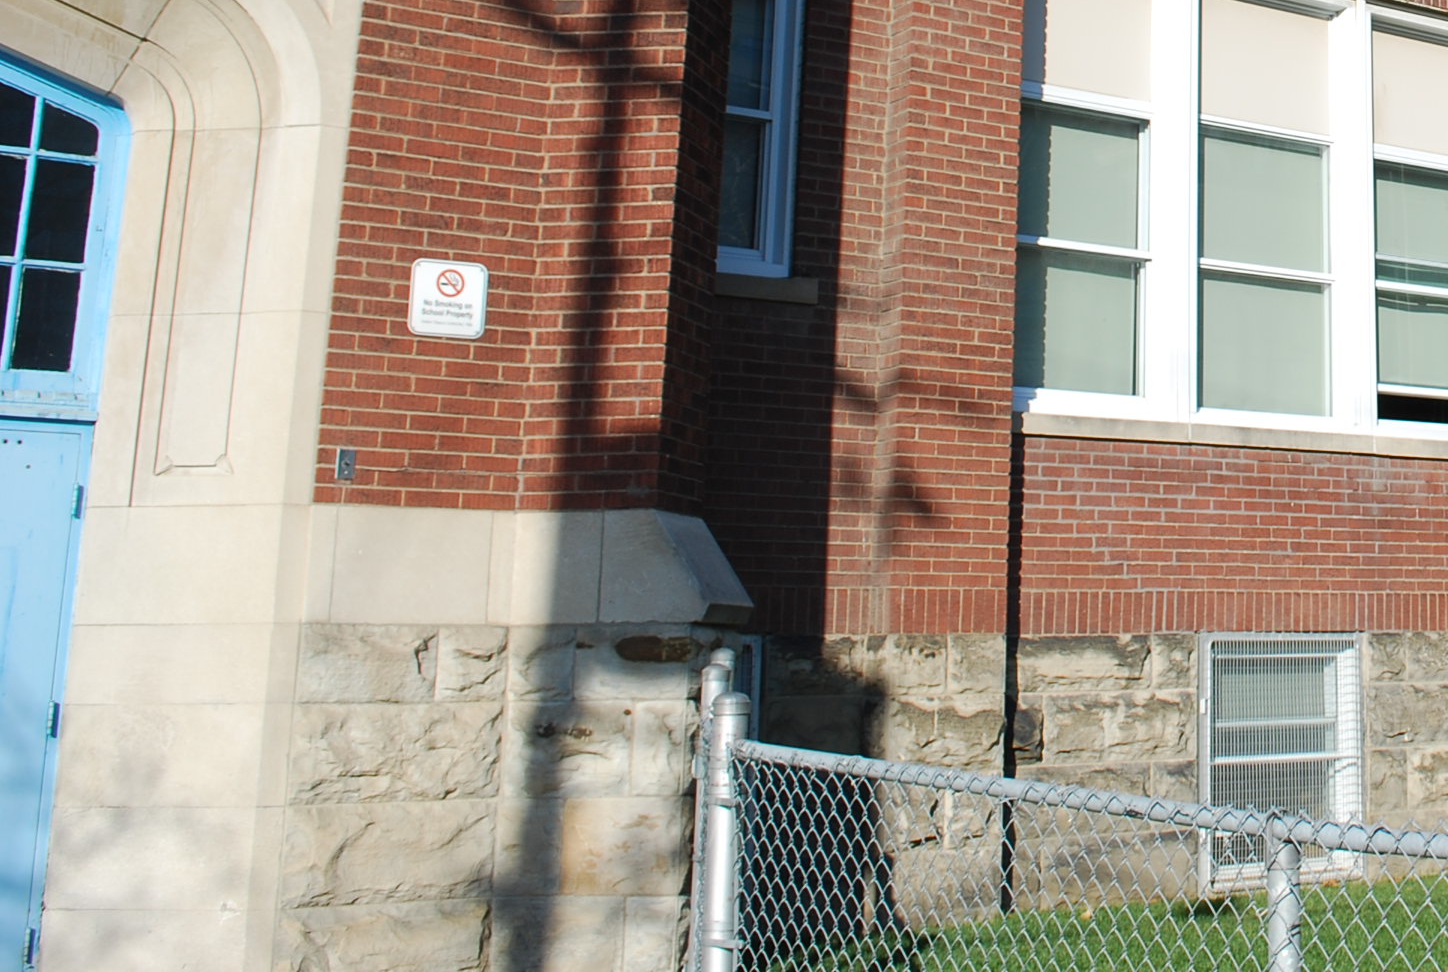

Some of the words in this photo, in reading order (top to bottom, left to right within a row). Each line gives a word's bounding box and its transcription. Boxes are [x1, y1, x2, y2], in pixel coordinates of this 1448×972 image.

[434, 299, 463, 310] Smoking
[421, 307, 444, 316] School
[446, 309, 473, 320] Property
